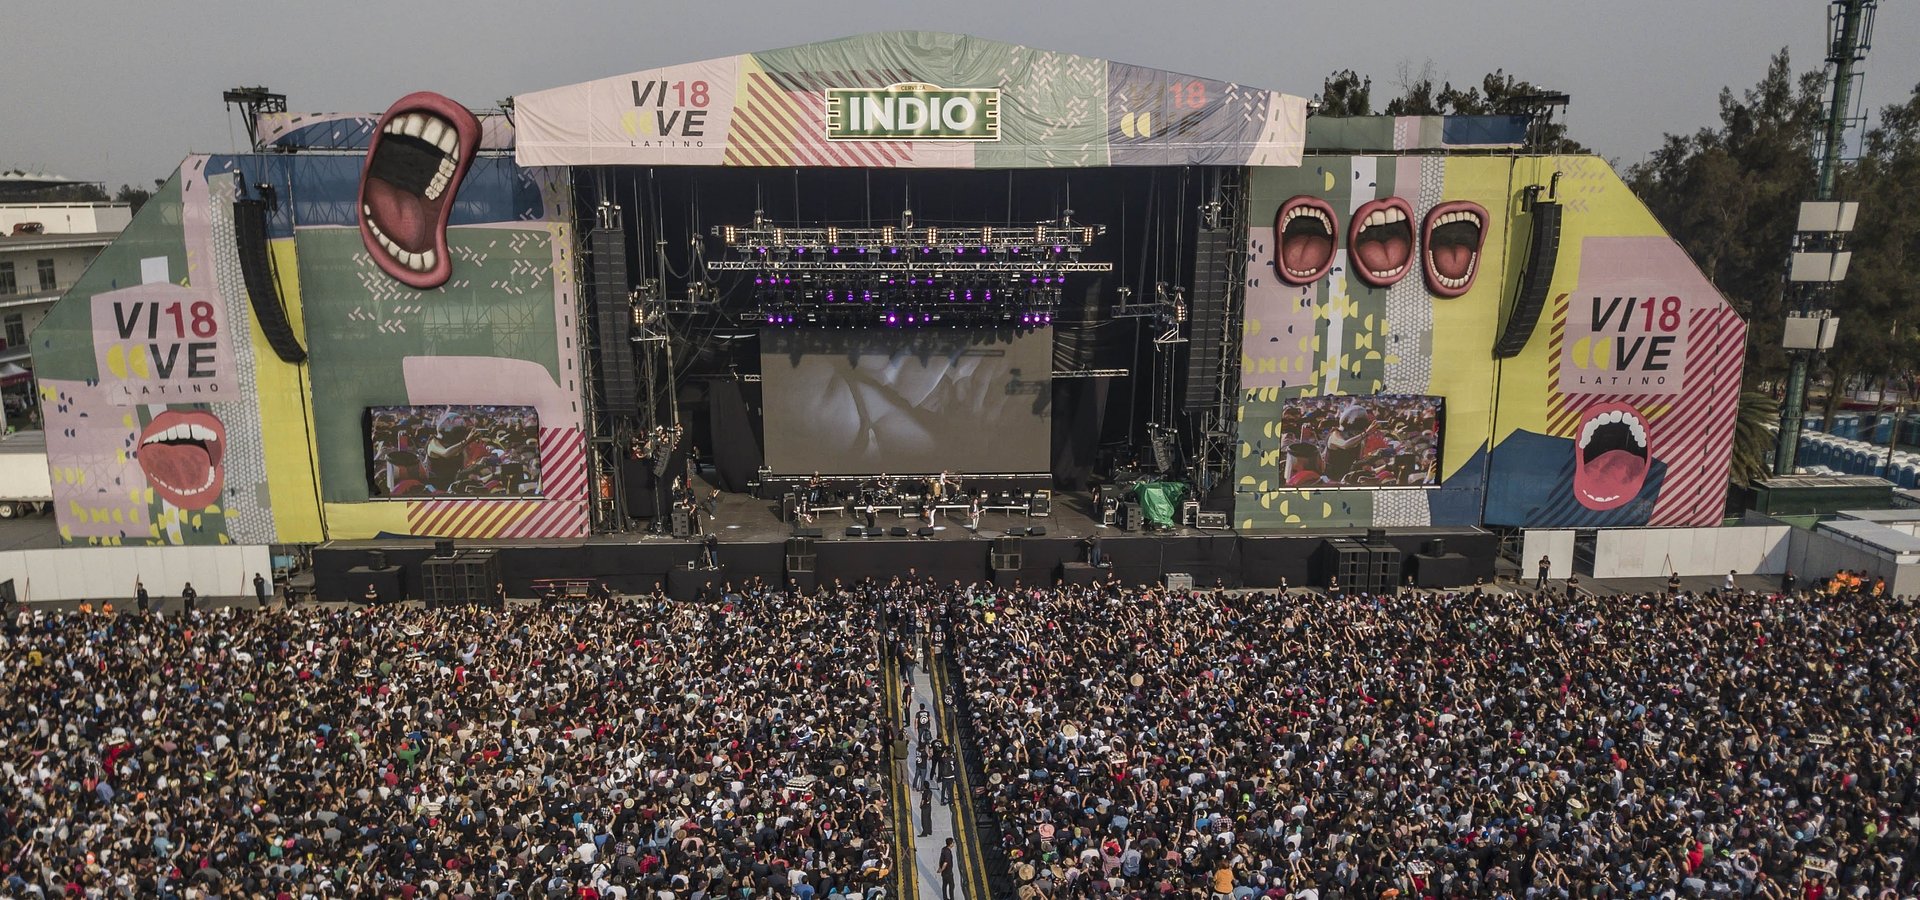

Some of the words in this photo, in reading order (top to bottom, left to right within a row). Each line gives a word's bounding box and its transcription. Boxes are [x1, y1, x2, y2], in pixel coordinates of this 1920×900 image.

[850, 96, 977, 131] INDIO
[631, 140, 704, 148] LATINO
[1579, 376, 1666, 386] LATINO
[123, 383, 219, 395] LATINO
